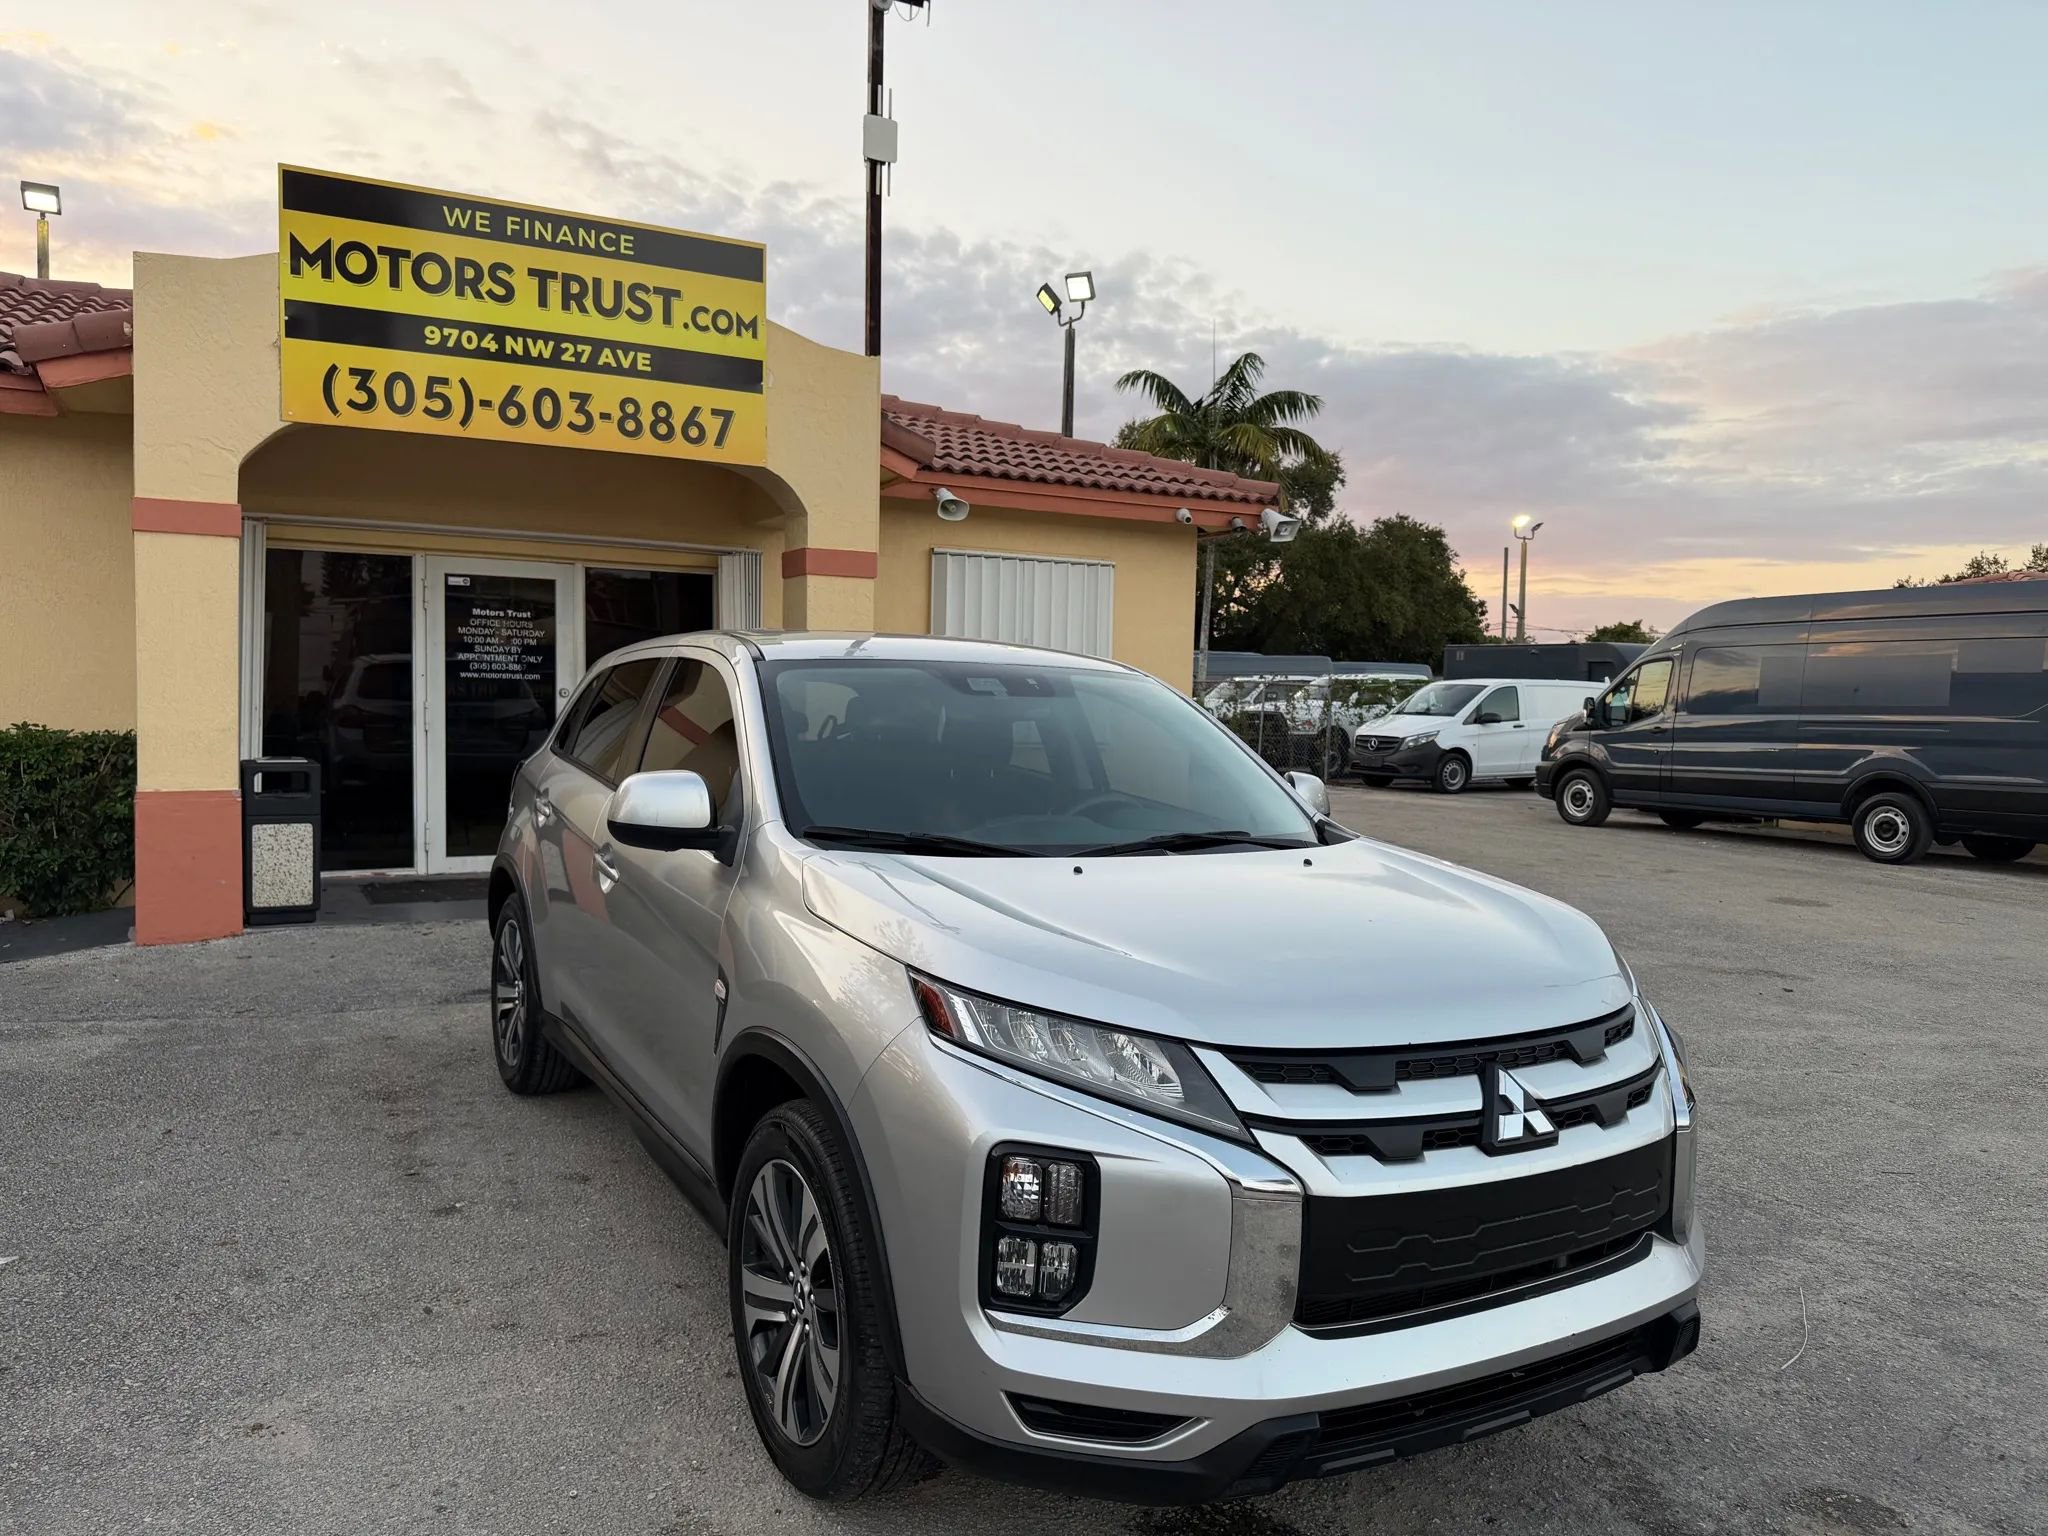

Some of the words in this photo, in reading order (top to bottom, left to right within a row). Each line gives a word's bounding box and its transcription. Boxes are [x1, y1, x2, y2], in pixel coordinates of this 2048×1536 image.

[443, 205, 491, 232] WE
[507, 217, 635, 255] FINANCE
[289, 231, 515, 304] MOTORS
[424, 325, 498, 352] 9704
[505, 336, 555, 360] NW
[561, 343, 592, 364] 27
[597, 347, 652, 372] AVE
[322, 363, 735, 449] (305)-603-8867
[472, 608, 504, 617] Motors
[507, 609, 531, 618] Trust
[470, 618, 500, 627] OFFICE
[503, 620, 533, 629] HOURS
[458, 626, 495, 635] MONDAY
[501, 628, 545, 637] SATURDAY
[464, 636, 484, 644] 10:00
[524, 638, 537, 646] PM
[474, 644, 510, 653] SUNDAY
[511, 646, 522, 654] BY
[521, 655, 543, 663] ONLY
[460, 671, 541, 680] www.motorstrust.com
